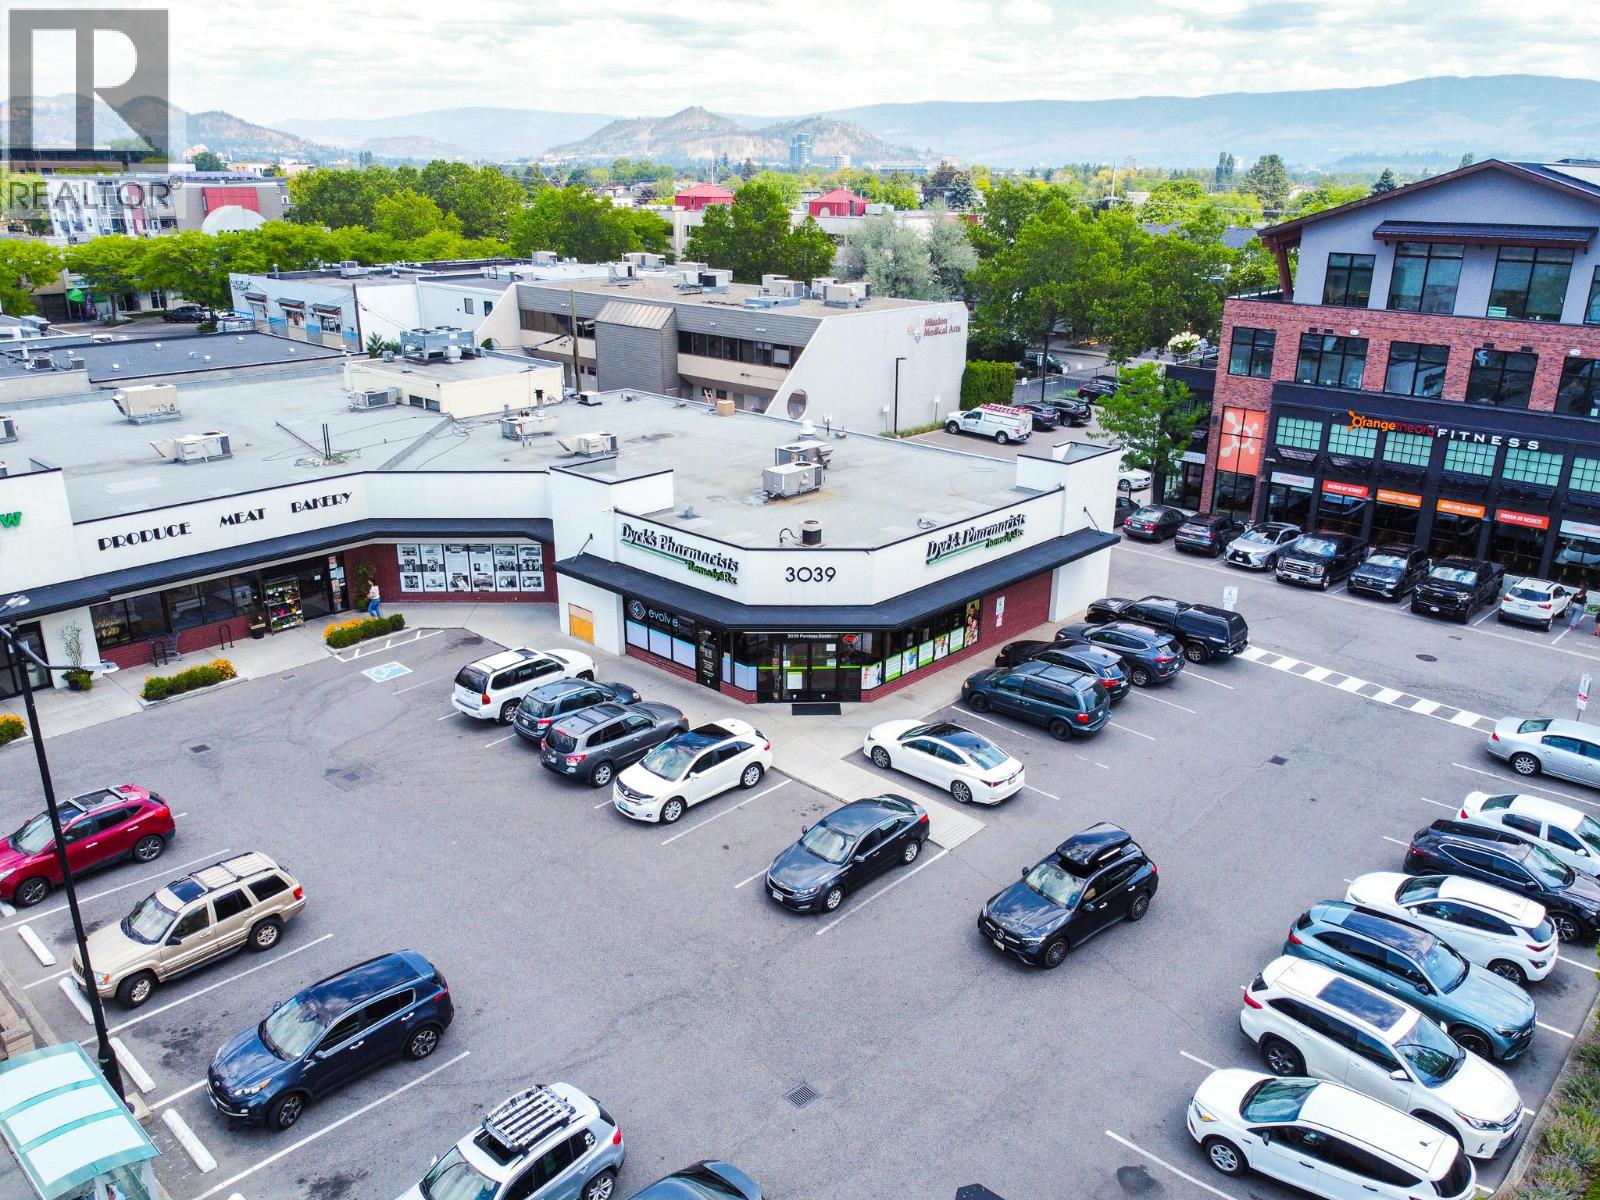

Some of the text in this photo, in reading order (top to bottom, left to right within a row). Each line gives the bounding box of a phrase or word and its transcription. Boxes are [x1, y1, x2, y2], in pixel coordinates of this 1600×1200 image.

[924, 318, 948, 326] Mission
[924, 325, 961, 336] Medical Arts
[1437, 428, 1540, 450] FITNESS
[97, 491, 352, 551] PRODUCE MEAT BAKERY
[926, 513, 1026, 559] Dyck's Pharmacists
[622, 522, 740, 573] Dyck's Pharmacists
[785, 566, 836, 583] 3039
